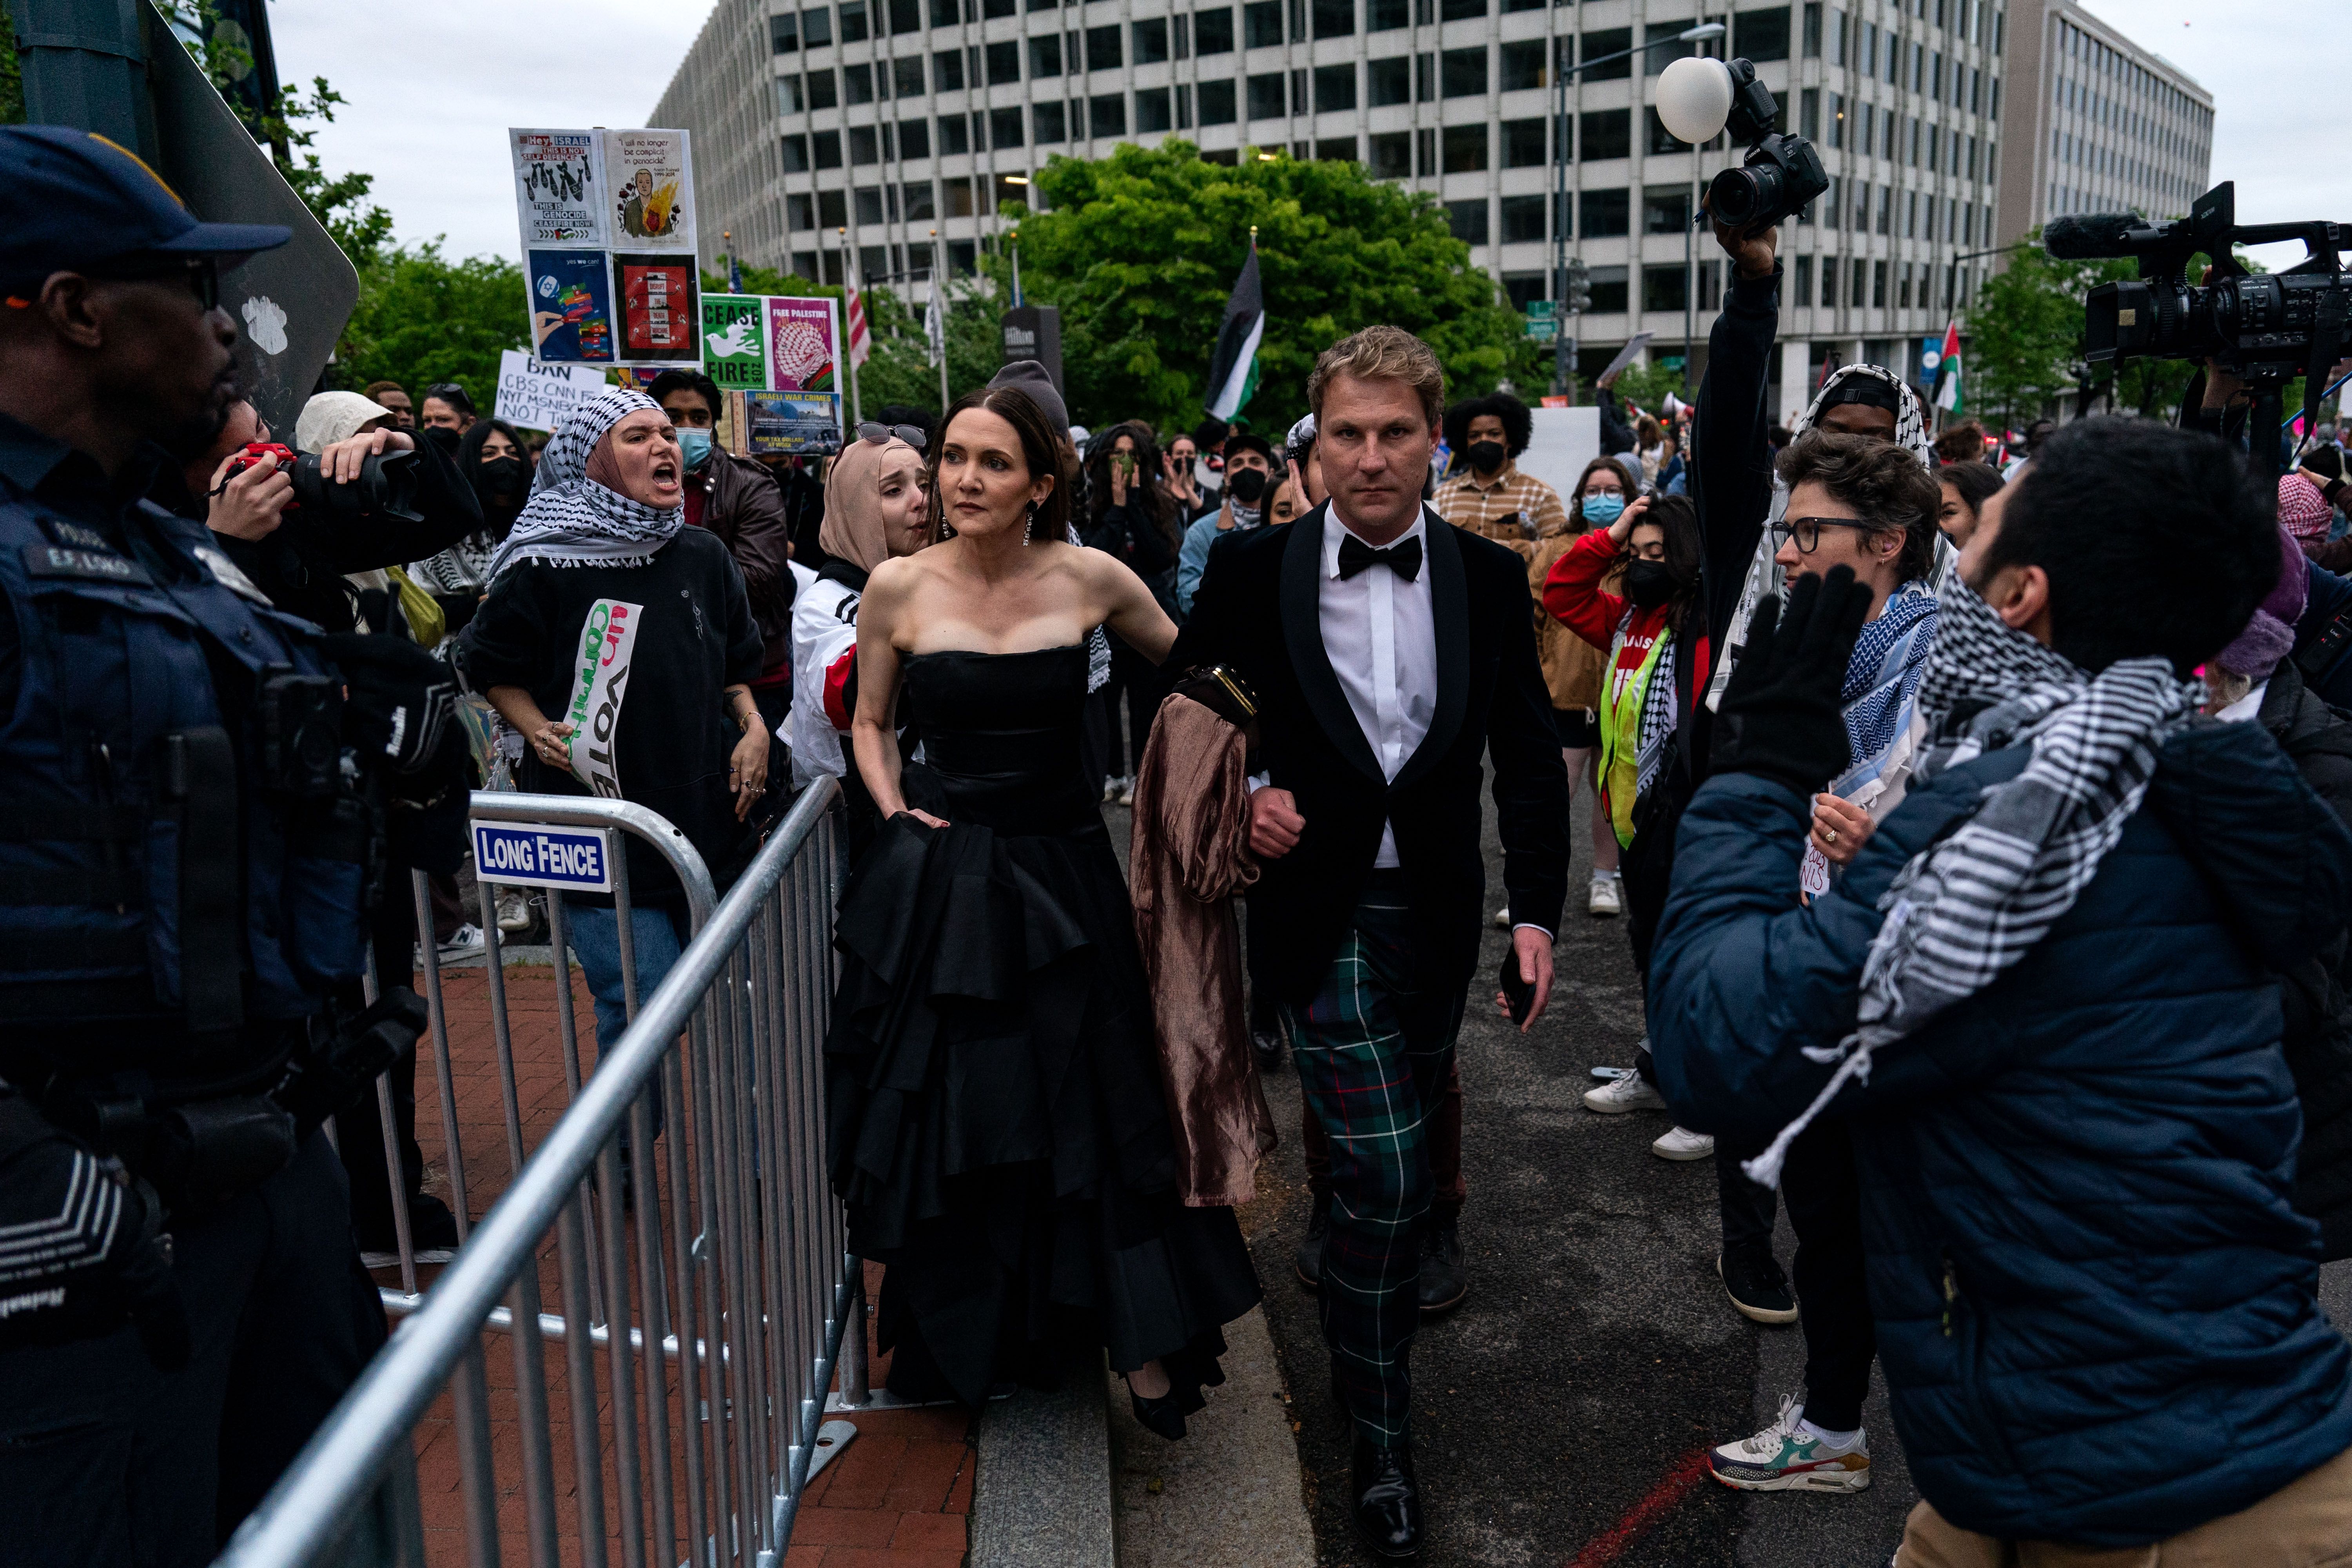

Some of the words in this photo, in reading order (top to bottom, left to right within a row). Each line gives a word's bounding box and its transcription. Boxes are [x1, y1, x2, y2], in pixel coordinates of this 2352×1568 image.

[529, 136, 552, 146] Hey,
[555, 136, 590, 145] ISRAEL
[647, 139, 669, 147] longer
[636, 148, 665, 156] complicit
[1745, 148, 1760, 161] Canon
[703, 305, 759, 326] CEASE
[791, 309, 828, 318] PALESTINE
[707, 362, 749, 382] FIRE
[751, 363, 762, 383] NOW
[499, 387, 524, 403] NYT
[505, 373, 538, 393] CBS
[543, 382, 576, 400] CNN
[503, 402, 543, 422] NOT
[602, 605, 628, 667] un
[589, 665, 628, 799] VOTE
[481, 831, 534, 871] LONG
[537, 836, 599, 877] FENCE
